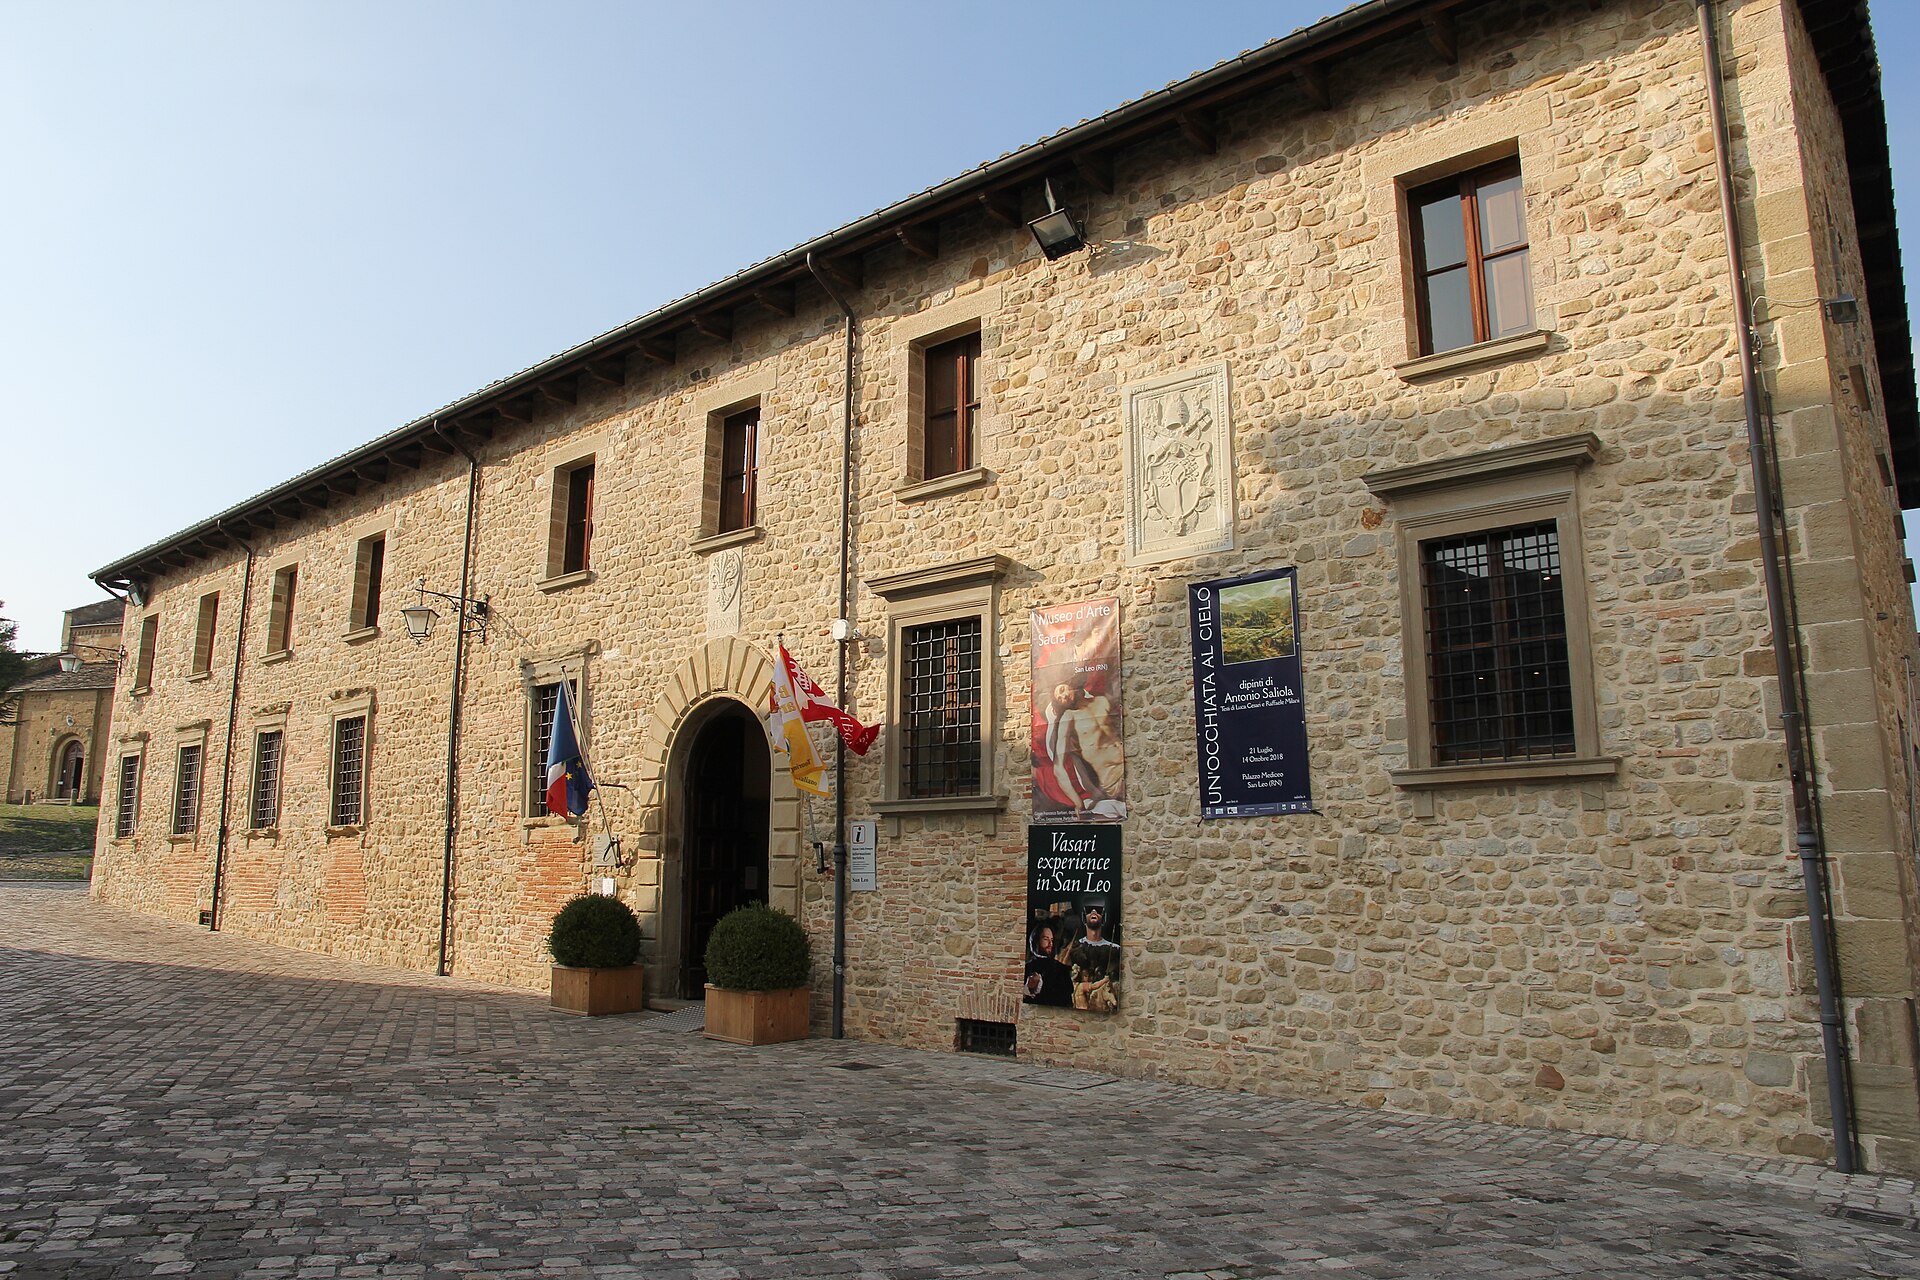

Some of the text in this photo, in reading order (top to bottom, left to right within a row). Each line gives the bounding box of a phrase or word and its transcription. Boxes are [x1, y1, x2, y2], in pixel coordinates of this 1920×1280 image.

[1038, 605, 1111, 626] Museo d'Arte
[1038, 633, 1066, 647] Sacra
[1074, 663, 1108, 674] San Leo (RN)
[1239, 676, 1274, 691] dipinti di
[1197, 587, 1222, 805] UN'OCCHIATA AL CIELO
[1224, 685, 1294, 704] Antonio Saliola
[1248, 746, 1274, 755] 21 Luglio
[1242, 753, 1284, 764] 14 Ottobre 2018
[1242, 771, 1284, 781] Palazzo Mediceo
[1247, 779, 1283, 789] San Leo (RN)
[1051, 831, 1097, 852] Vasari
[1037, 852, 1111, 878] experience
[1036, 871, 1111, 893] in San Leo
